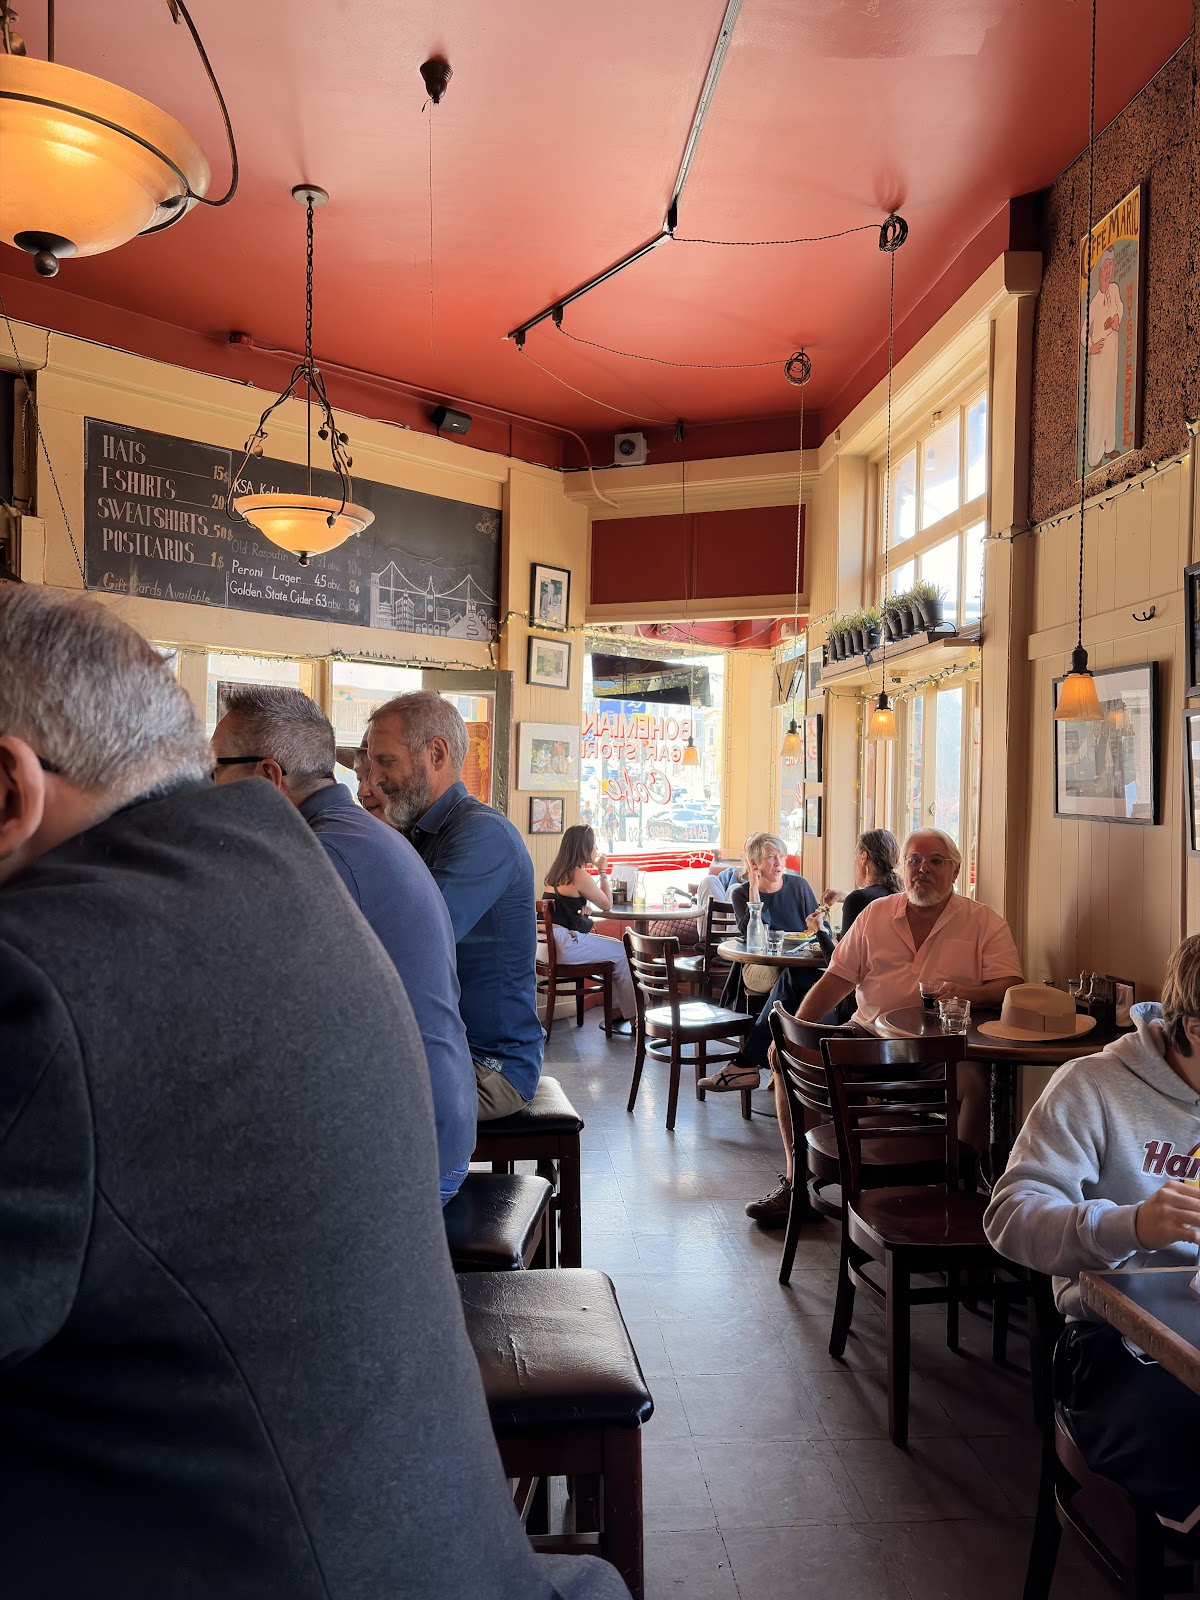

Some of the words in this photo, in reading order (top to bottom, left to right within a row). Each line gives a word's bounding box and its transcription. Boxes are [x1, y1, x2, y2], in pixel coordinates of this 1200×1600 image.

[1081, 221, 1107, 280] CFFÉ
[1107, 192, 1139, 245] MARIO
[102, 434, 147, 465] HATS
[98, 465, 176, 500] T-SHIRTS
[211, 493, 228, 511] 20
[233, 479, 255, 495] KSA
[97, 496, 209, 537] SWEATSHIRTS
[213, 523, 234, 541] 50$
[102, 527, 195, 564] POSTCARDS
[209, 551, 225, 570] 1$
[231, 539, 248, 555] Old
[251, 542, 289, 562] Rasputin
[103, 571, 127, 592] Gift
[129, 574, 162, 598] Cards
[164, 582, 211, 604] Available
[232, 559, 264, 578] Peroni
[272, 565, 302, 586] Lager
[229, 580, 262, 598] Golden
[264, 585, 288, 601] State
[289, 589, 314, 606] Cider
